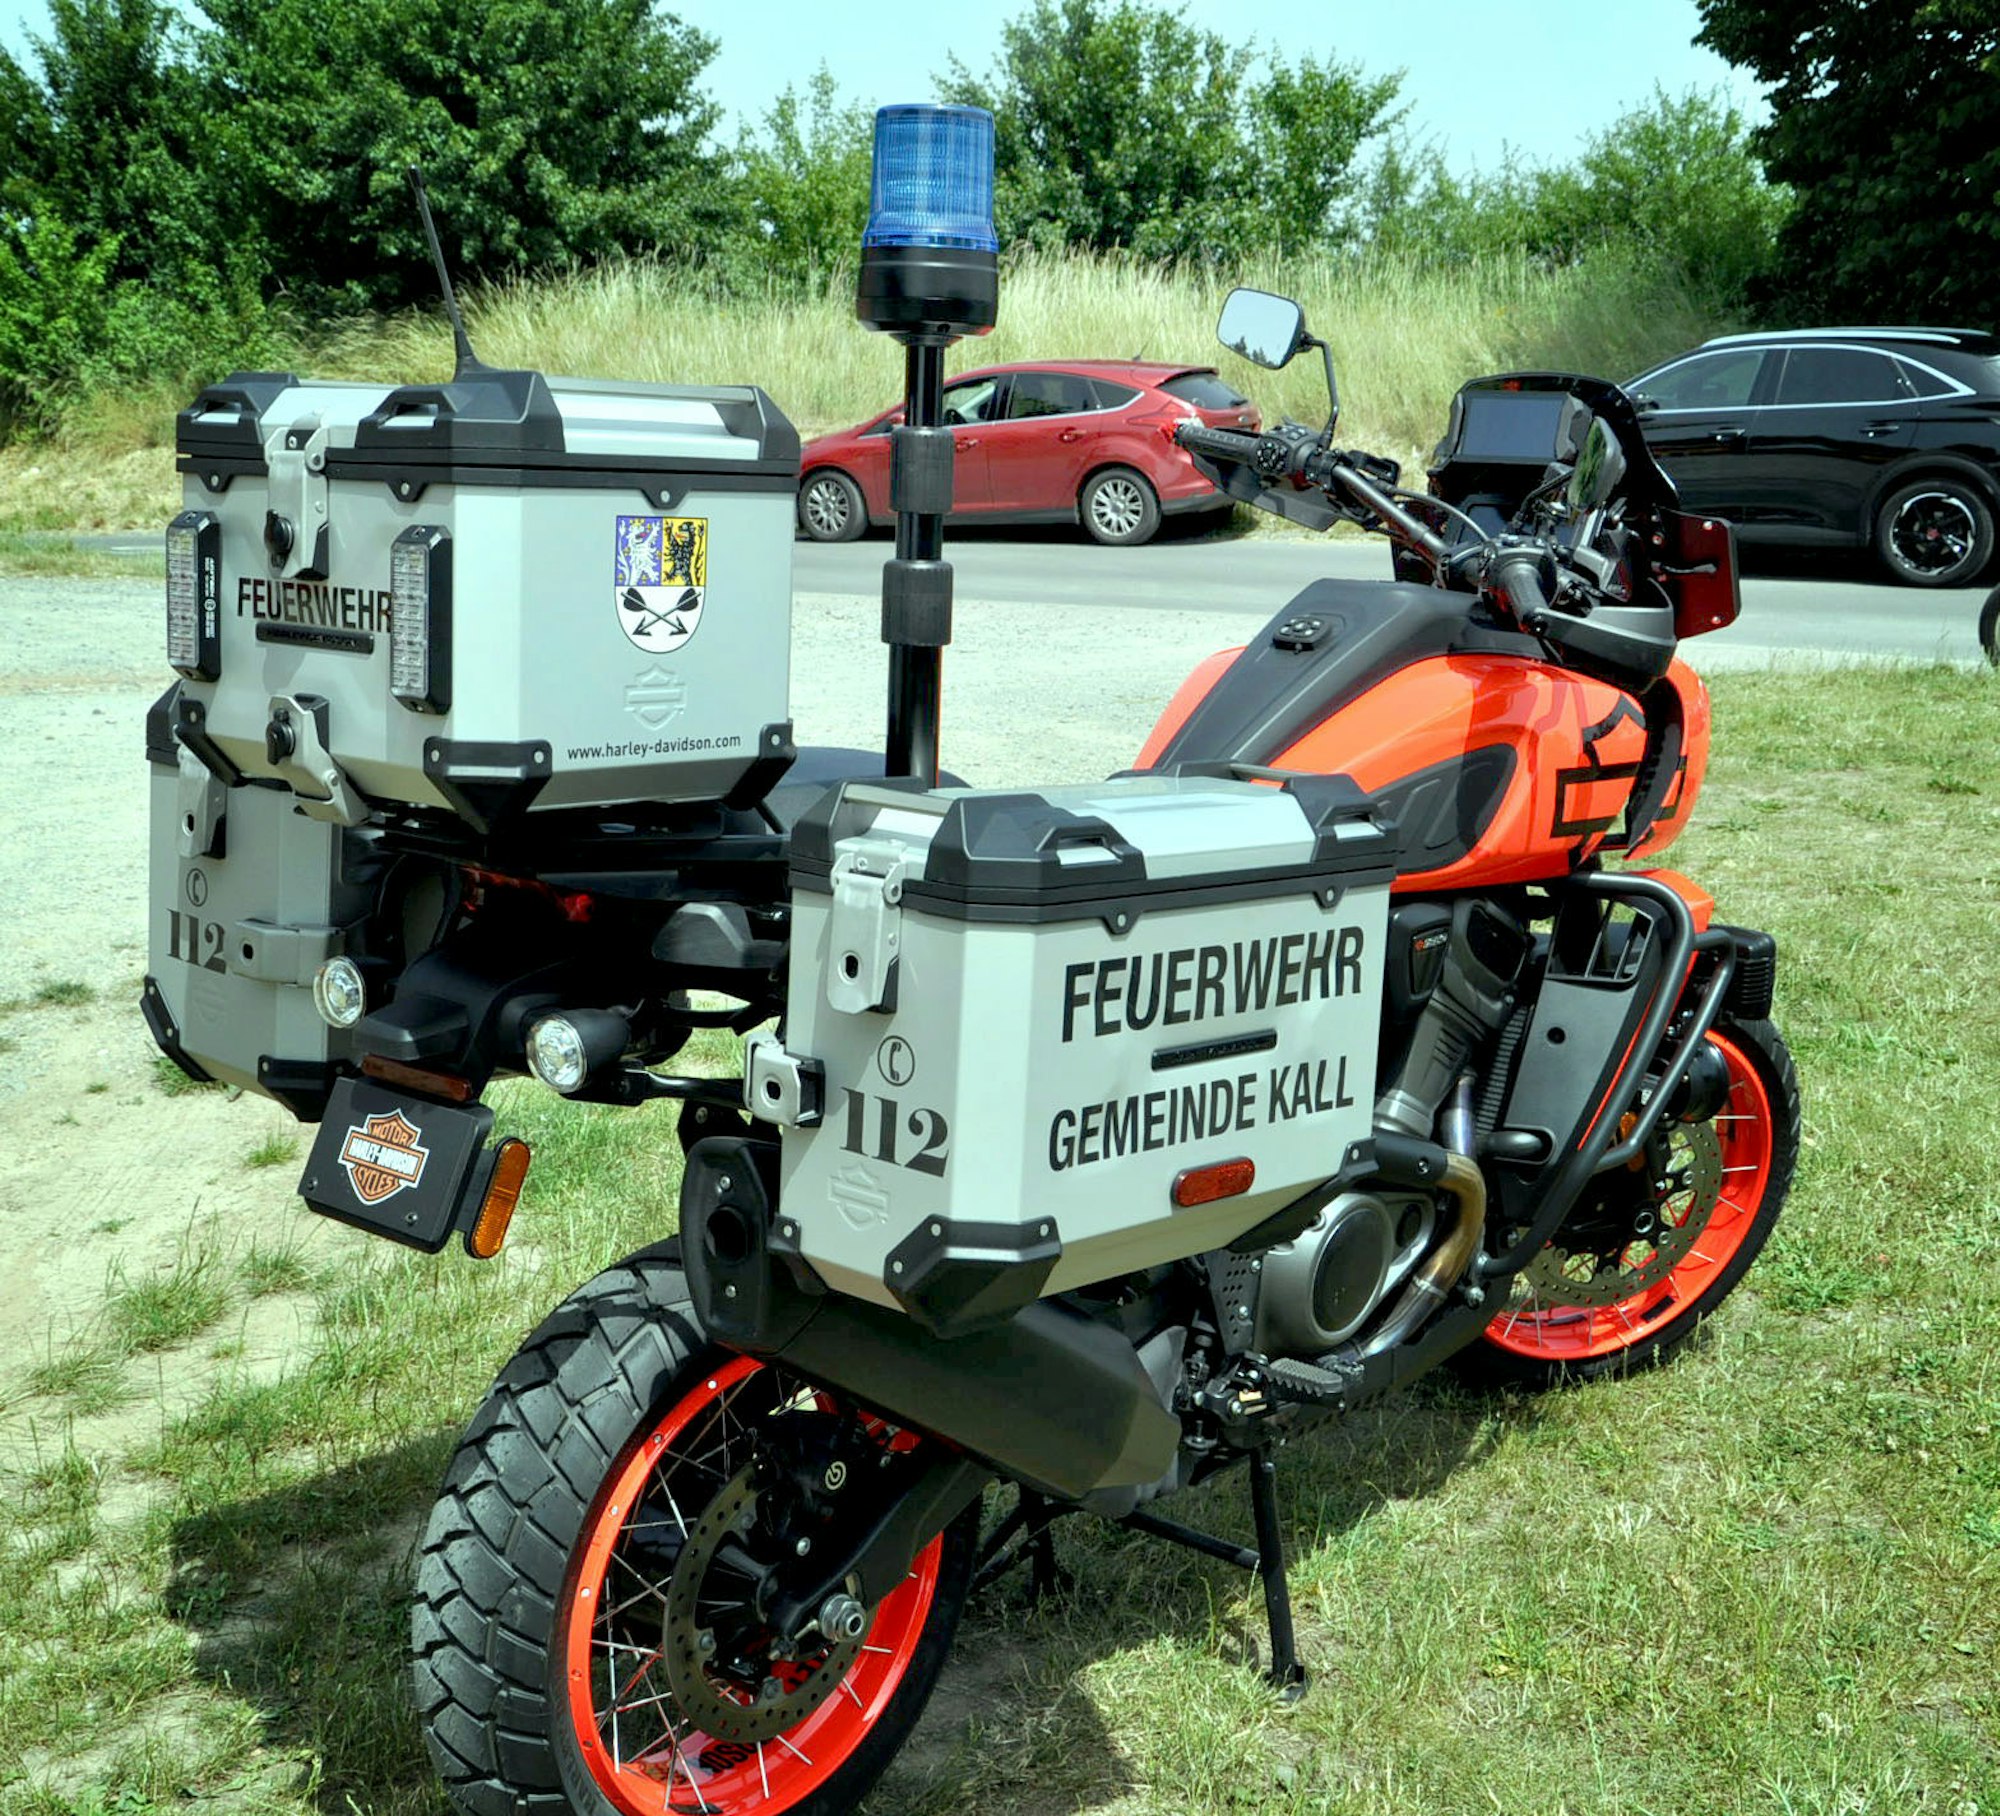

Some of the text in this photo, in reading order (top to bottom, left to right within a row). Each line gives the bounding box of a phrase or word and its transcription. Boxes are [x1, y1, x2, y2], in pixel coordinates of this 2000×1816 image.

[237, 577, 392, 633] FEUERWEHR
[567, 735, 741, 760] www.harley-davidson.com
[166, 907, 226, 975] 112
[1062, 925, 1364, 1042] FEUERWEHR
[371, 1121, 410, 1147] MOTOR
[840, 1086, 949, 1178] 112
[1049, 1055, 1354, 1172] GEMEINDE KALL
[358, 1166, 394, 1195] CYCLES
